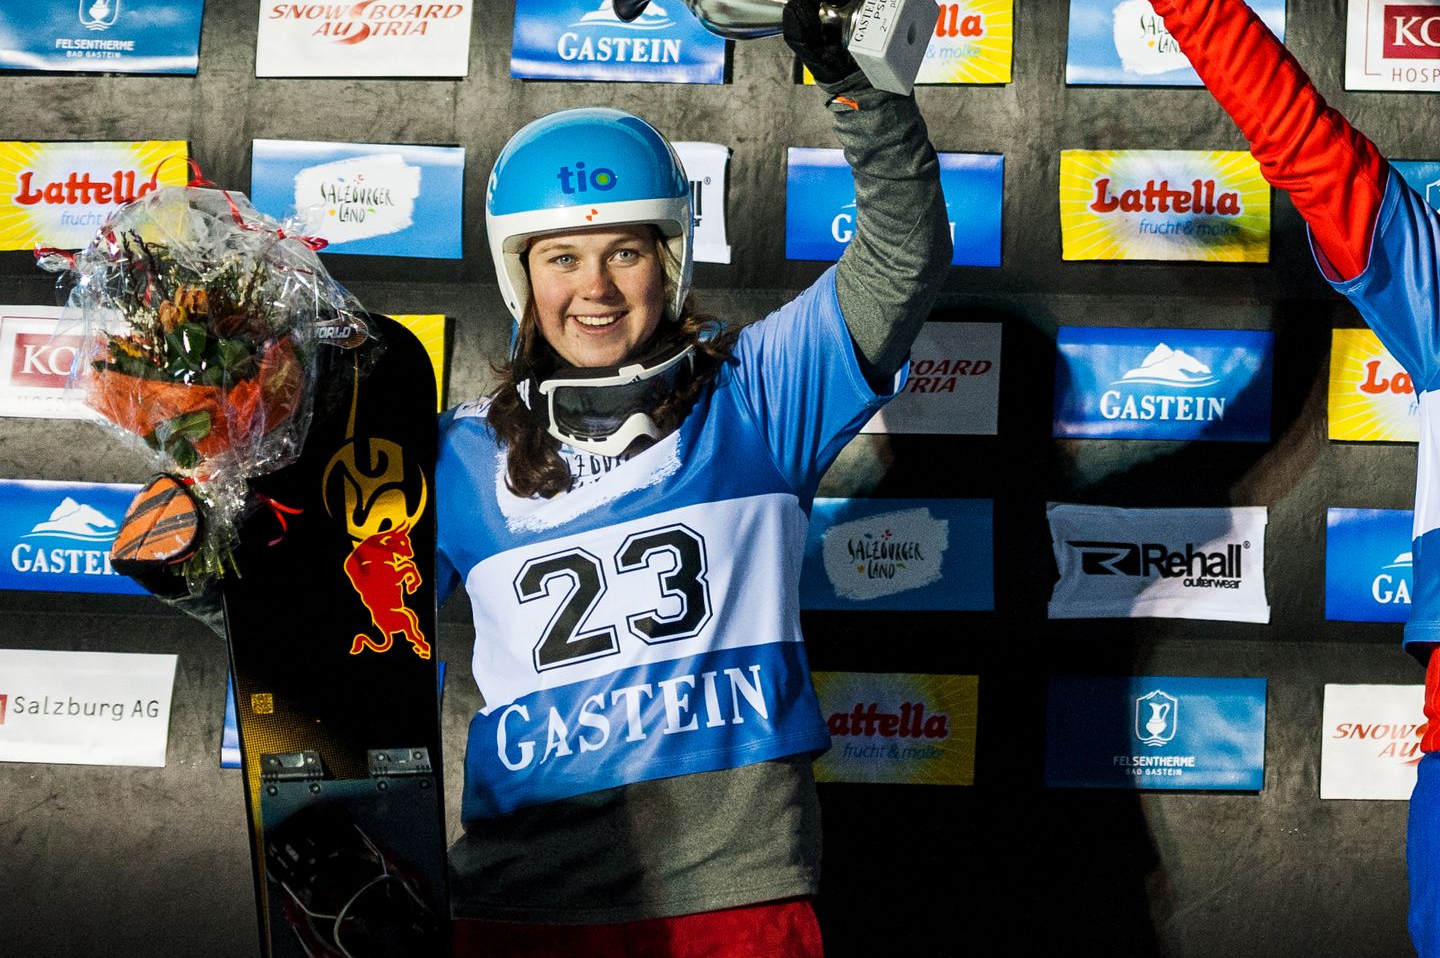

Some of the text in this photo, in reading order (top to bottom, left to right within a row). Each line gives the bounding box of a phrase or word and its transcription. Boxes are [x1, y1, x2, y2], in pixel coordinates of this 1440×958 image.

[268, 0, 464, 20] SNOWBOARD
[55, 38, 135, 51] FELSENTHERME
[66, 50, 121, 59] BAD GASTEIN
[557, 32, 681, 64] GASTEIN
[940, 44, 981, 59] molke
[557, 161, 617, 195] tio
[320, 182, 394, 207] SALZBURGER
[1089, 178, 1241, 215] Lattella
[60, 210, 102, 226] frucht
[338, 203, 366, 224] LAND
[1139, 218, 1179, 236] frucht
[1100, 390, 1226, 422] GASTEIN
[847, 539, 925, 565] SALZBURGER
[1142, 543, 1241, 579] Rehall
[866, 560, 897, 580] LAND
[1183, 578, 1241, 589] outerwear
[512, 523, 714, 674] 23
[13, 696, 160, 722] Salzburg AG
[497, 664, 769, 772] GASTEIN
[1113, 755, 1195, 767] FELSENTHERME
[1144, 768, 1182, 776] GASTEIN
